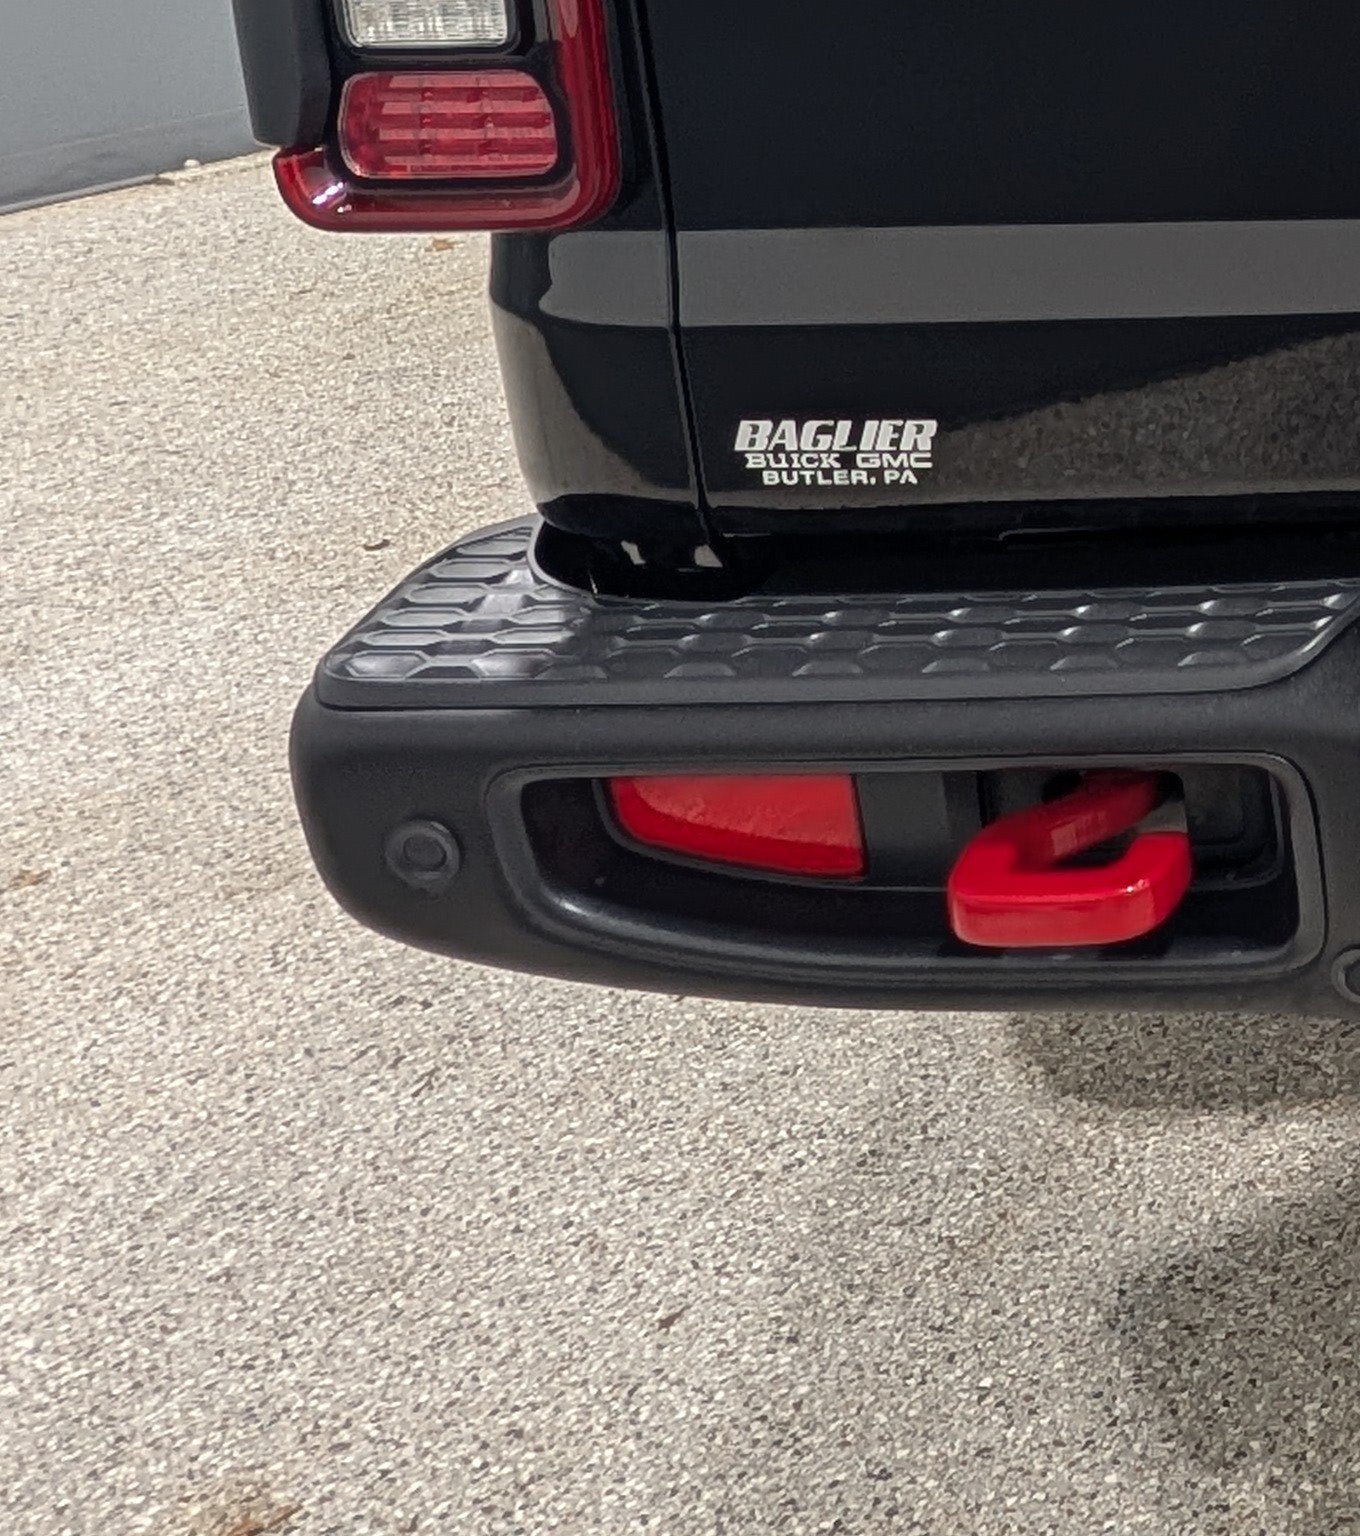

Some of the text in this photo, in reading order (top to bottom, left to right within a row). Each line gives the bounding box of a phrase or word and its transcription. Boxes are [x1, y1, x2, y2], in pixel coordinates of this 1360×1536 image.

[735, 420, 938, 451] BAGLIER
[745, 453, 933, 468] BUICK GMC
[762, 470, 918, 485] BUTLER, PA
